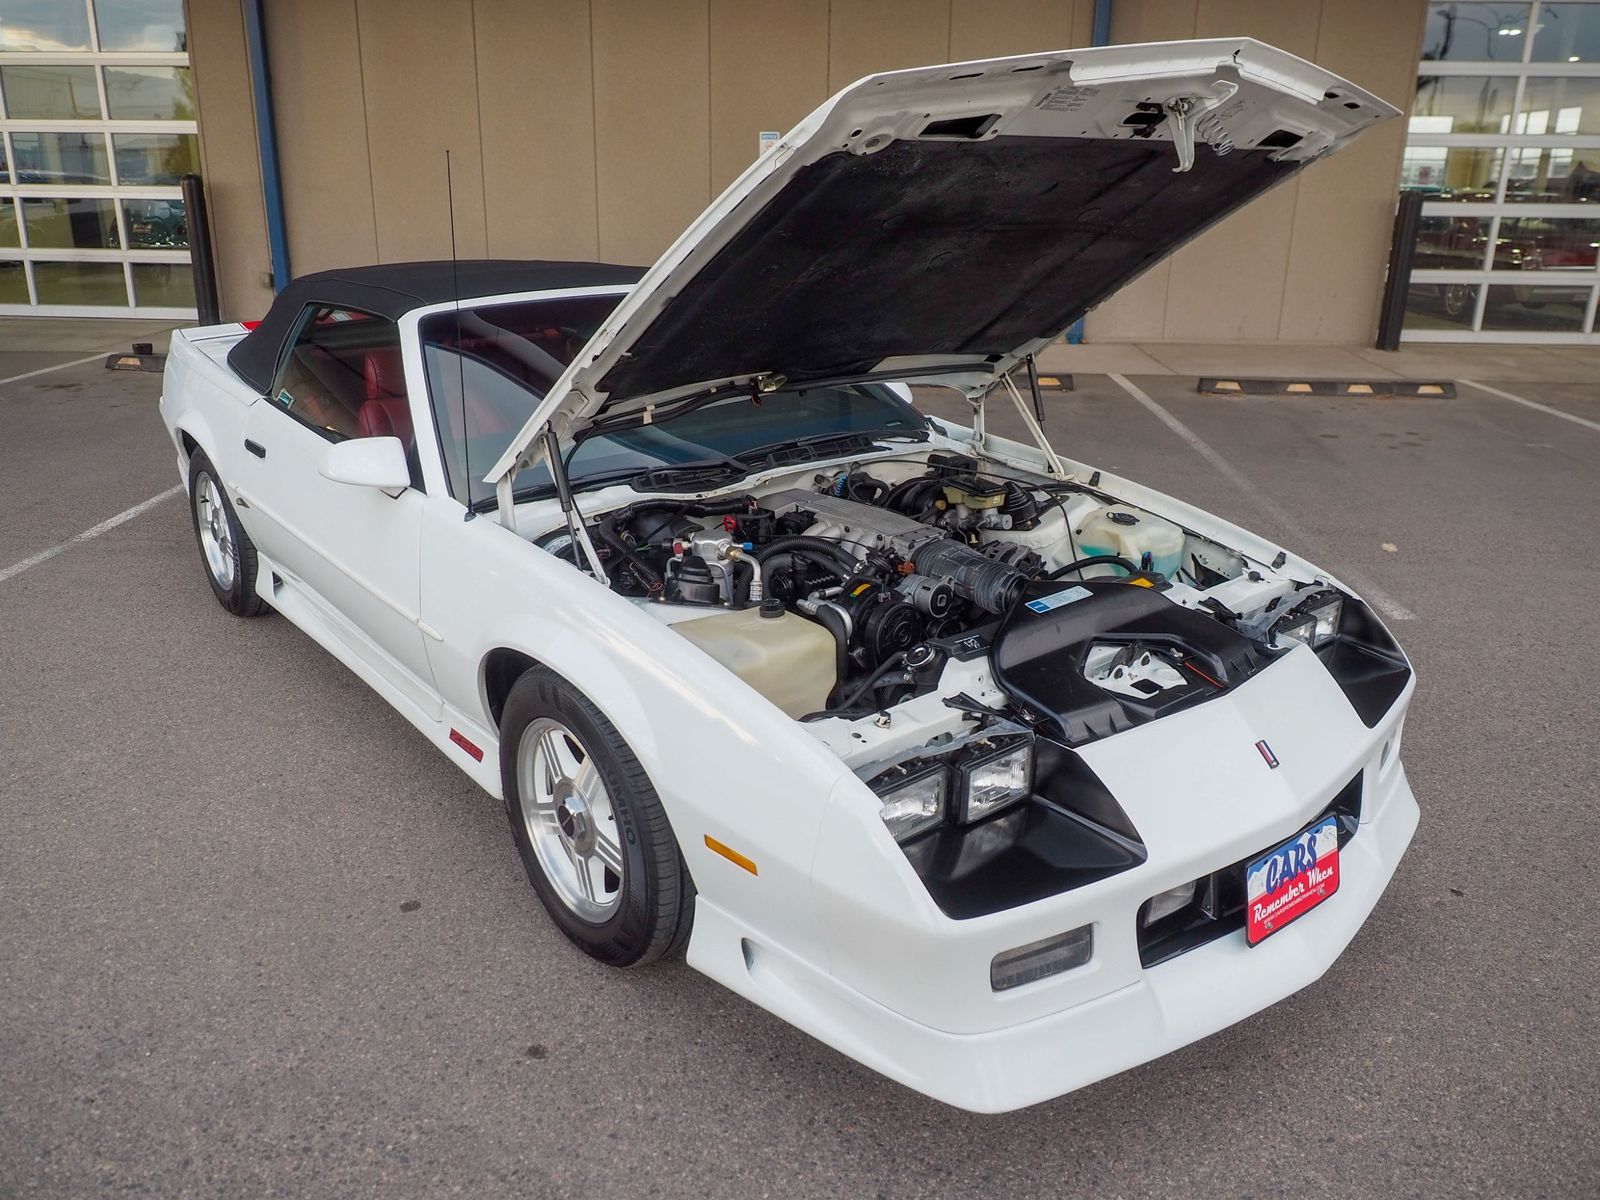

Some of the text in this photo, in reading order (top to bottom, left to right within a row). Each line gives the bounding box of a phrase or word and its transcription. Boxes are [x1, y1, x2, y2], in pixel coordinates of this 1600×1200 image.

[1266, 834, 1317, 895] CARS
[1253, 866, 1333, 924] Remember When
